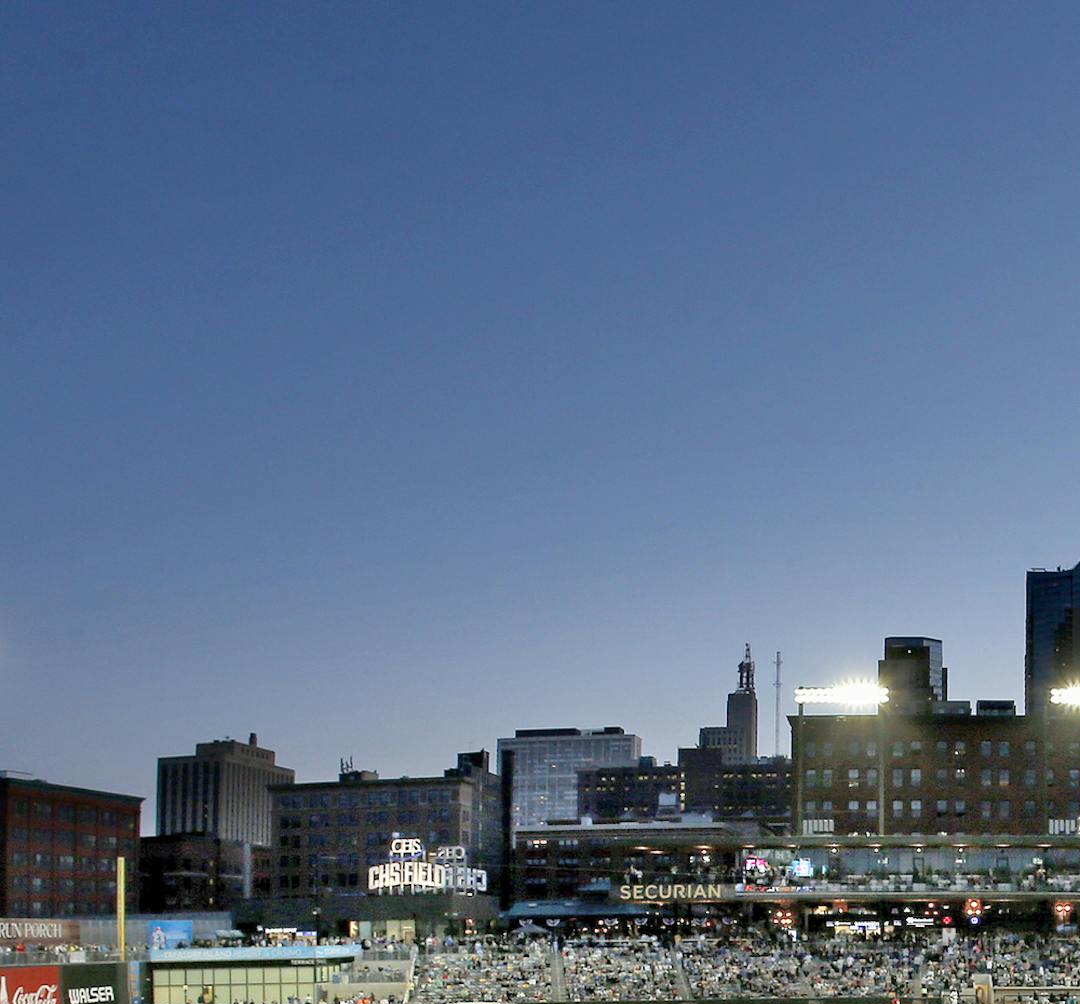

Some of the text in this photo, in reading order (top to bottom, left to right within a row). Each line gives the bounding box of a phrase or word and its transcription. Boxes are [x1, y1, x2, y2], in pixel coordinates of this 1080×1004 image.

[368, 864, 400, 890] CHS
[404, 861, 445, 889] FIELD
[619, 884, 721, 900] SECURIAN
[0, 922, 62, 938] RUN PORCH
[68, 985, 114, 1004] WALSER
